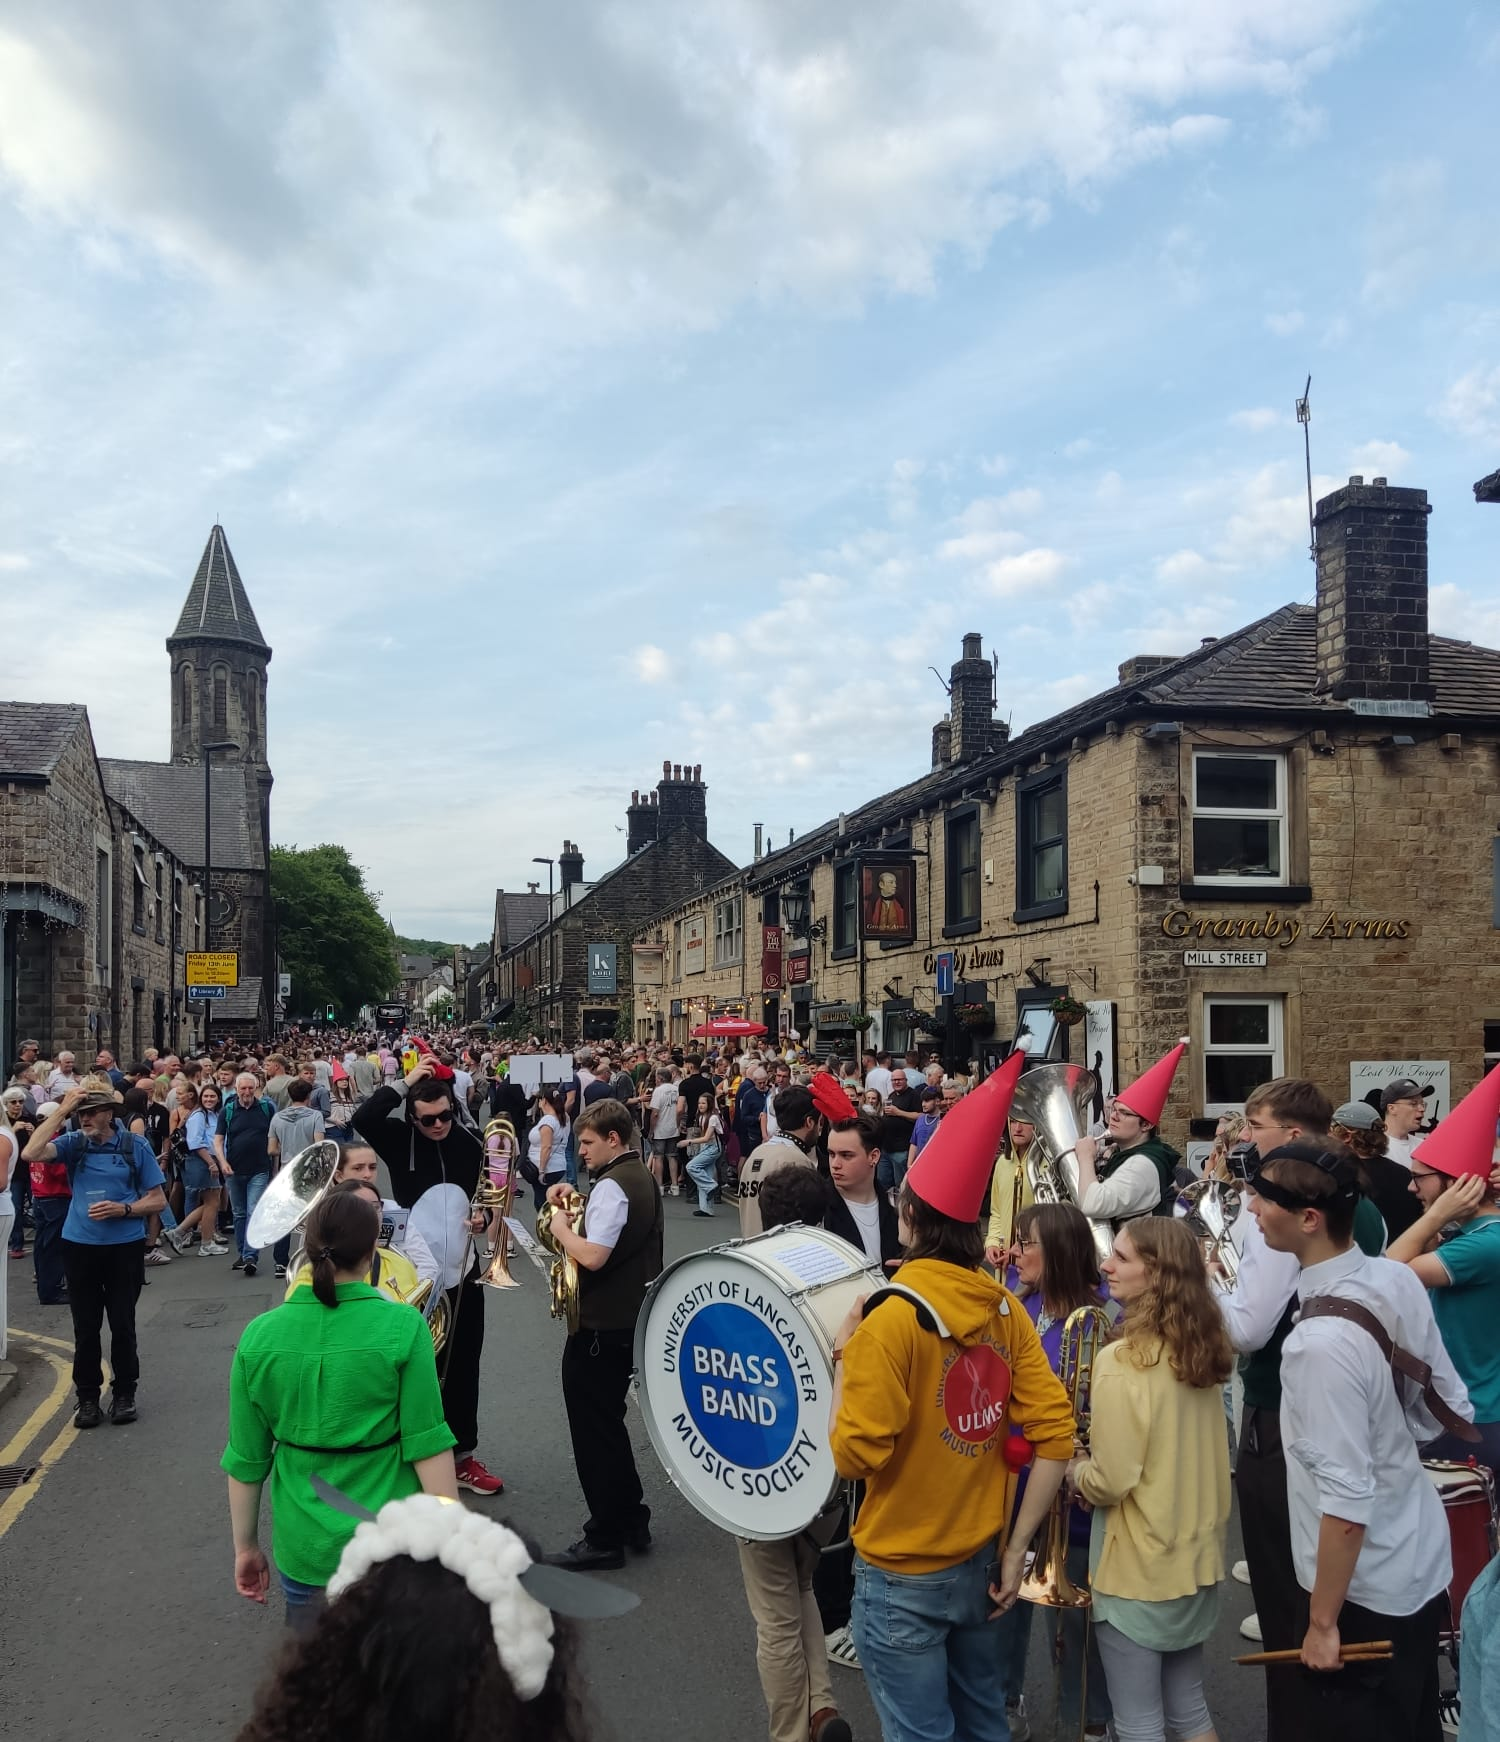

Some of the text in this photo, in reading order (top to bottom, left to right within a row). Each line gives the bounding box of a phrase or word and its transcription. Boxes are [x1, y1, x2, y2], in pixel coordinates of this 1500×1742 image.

[1161, 909, 1410, 948] Granby Arms
[923, 945, 1004, 977] Grby Arms
[1187, 953, 1264, 964] MILL STREET
[1355, 1064, 1447, 1087] Lest We Forget
[664, 1280, 817, 1403] UNIVERSITY OF LANCASTER
[693, 1345, 779, 1388] BRASS
[701, 1385, 777, 1427] BAND
[958, 1401, 1003, 1433] ULMS
[672, 1412, 818, 1497] MUSIC SOCIETY
[940, 1427, 980, 1458] MUSIC
